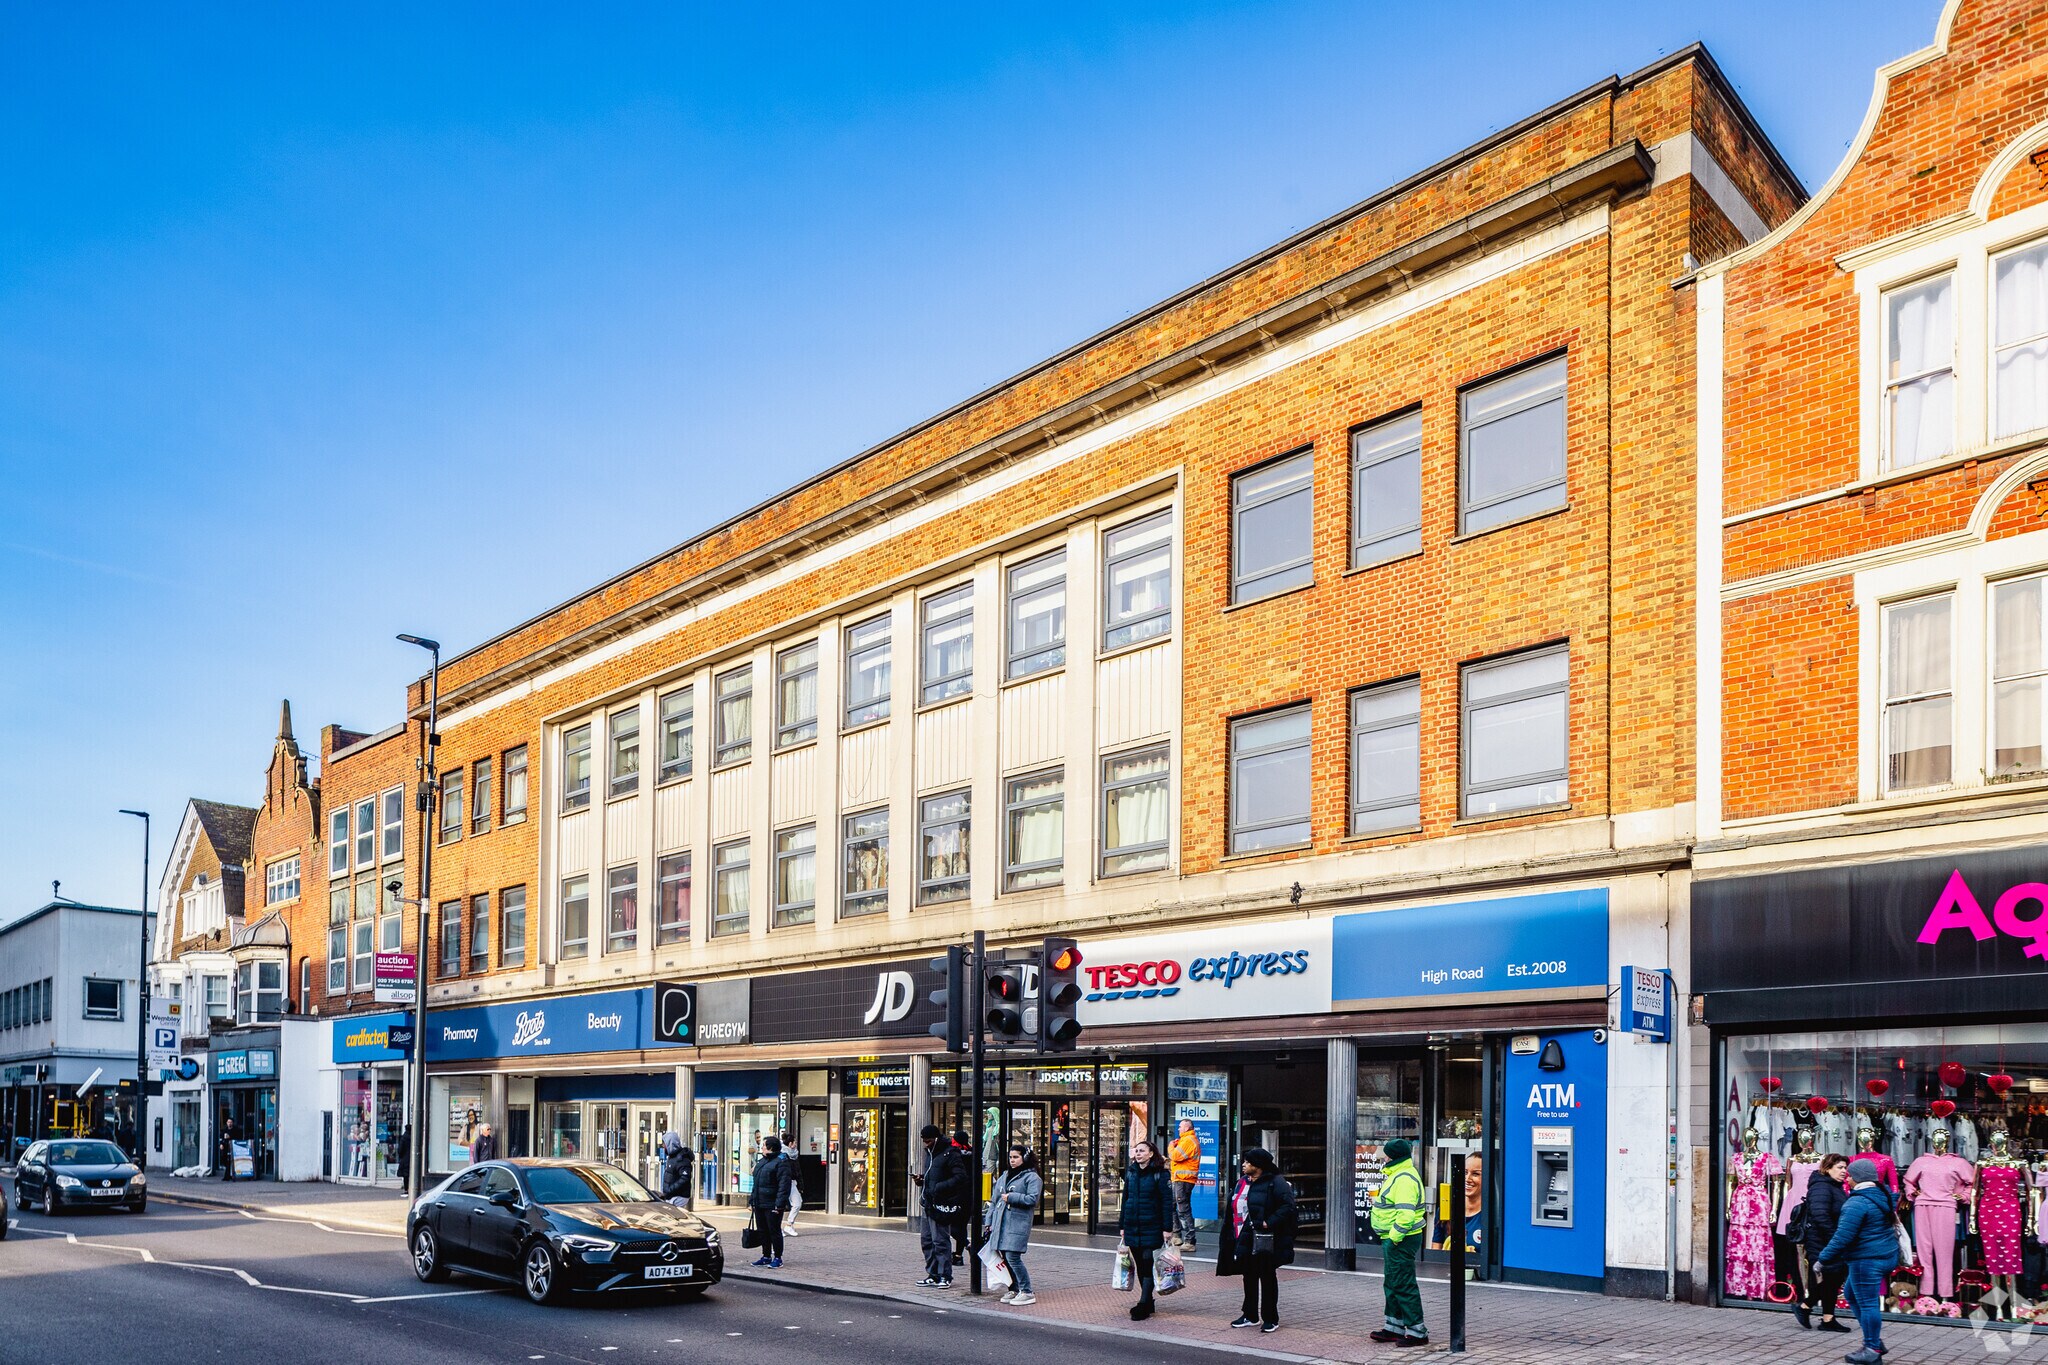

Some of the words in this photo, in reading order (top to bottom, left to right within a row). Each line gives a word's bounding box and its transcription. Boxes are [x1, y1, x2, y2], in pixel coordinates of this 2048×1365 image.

[377, 956, 409, 965] auction
[1085, 959, 1182, 990] TESCO
[1188, 950, 1309, 989] express
[1421, 970, 1448, 985] High
[1452, 967, 1484, 980] Road
[1507, 960, 1567, 977] Est.2008
[1636, 971, 1661, 988] TESCO
[391, 991, 414, 999] allsop
[864, 970, 915, 1025] JD
[1636, 994, 1661, 1011] express
[151, 1014, 181, 1023] Wembley
[588, 1012, 622, 1032] Beauty
[443, 1027, 479, 1043] Pharmacy
[512, 1010, 546, 1046] Boots
[698, 1021, 746, 1039] PUREGYM
[346, 1028, 389, 1049] cardfactory
[225, 1055, 247, 1074] GREG
[873, 1076, 894, 1086] KING
[894, 1077, 903, 1086] OF
[1039, 1069, 1128, 1083] JDSPORTS.O.UK
[1181, 1106, 1209, 1117] Hello.
[1537, 1110, 1551, 1118] Free
[1551, 1110, 1558, 1118] to
